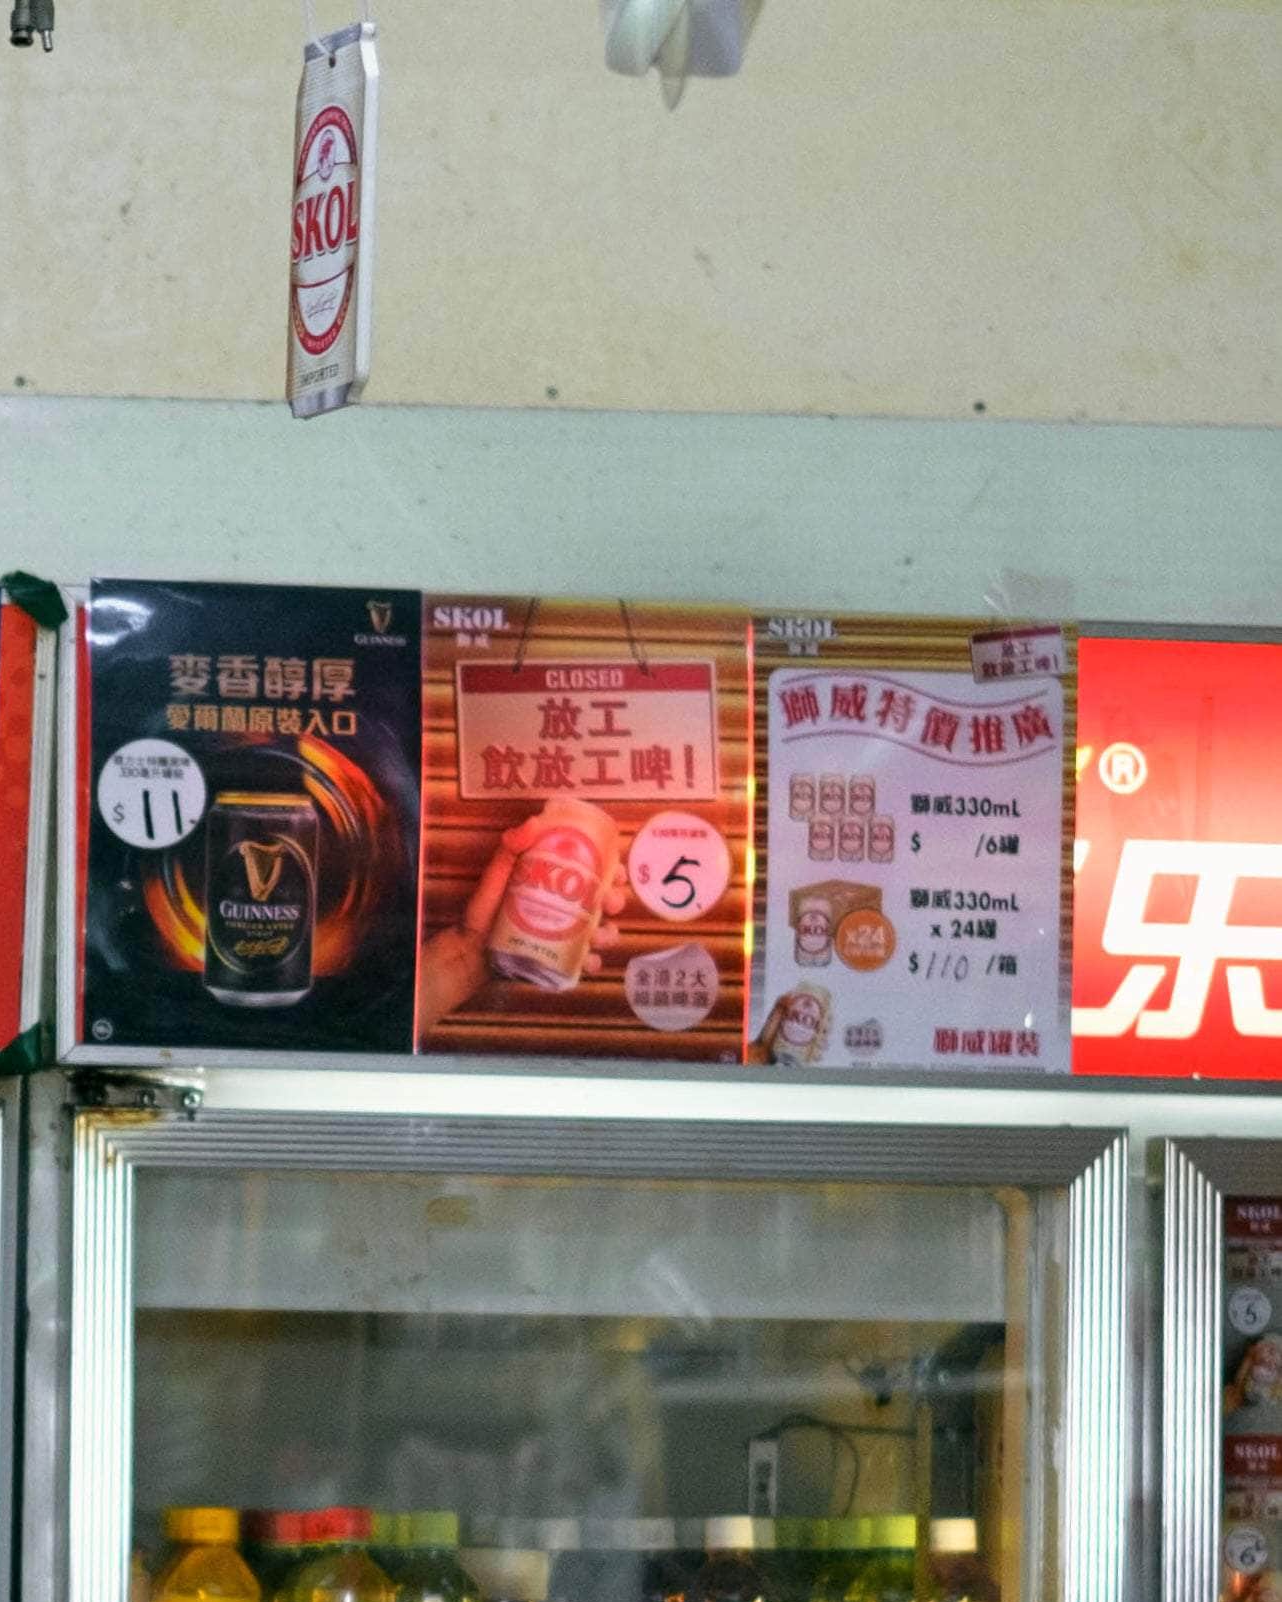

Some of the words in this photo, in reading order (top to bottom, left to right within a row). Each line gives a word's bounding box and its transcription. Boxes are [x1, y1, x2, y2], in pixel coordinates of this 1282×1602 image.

[290, 177, 359, 262] SKOL
[433, 606, 509, 629] SKOL
[354, 633, 407, 647] GUINNESS
[168, 653, 357, 701] 麥香醇厚
[544, 665, 624, 689] CLOSED
[538, 698, 632, 742] 放工
[113, 803, 126, 824] $
[911, 831, 922, 852] $
[660, 855, 700, 909] 5
[219, 899, 301, 921] GUINNESS
